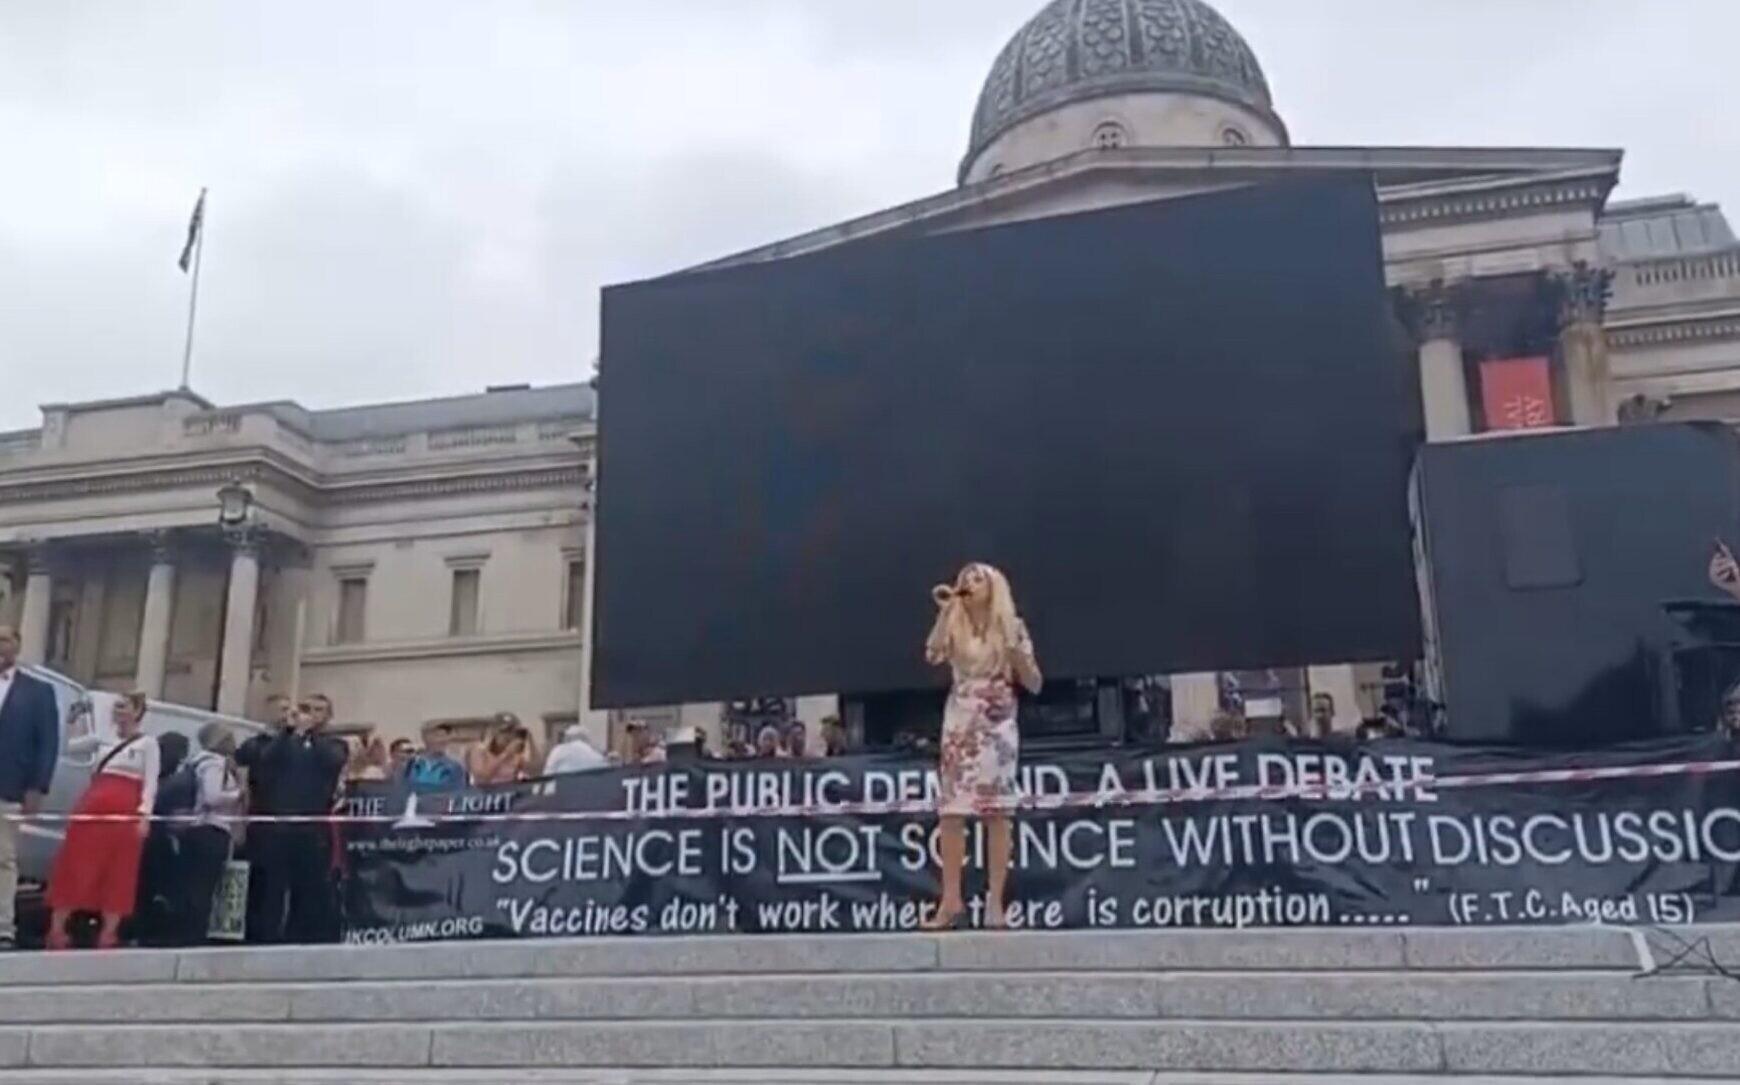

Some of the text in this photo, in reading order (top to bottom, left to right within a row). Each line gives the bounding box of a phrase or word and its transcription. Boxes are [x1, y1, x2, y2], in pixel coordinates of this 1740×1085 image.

[448, 792, 513, 812] LIGHT
[622, 774, 688, 818] THE
[706, 771, 850, 814] PUBLIC
[864, 765, 1069, 813] DEMND
[1098, 764, 1130, 806] A
[1145, 755, 1239, 800] LIVE
[1257, 753, 1438, 801] DEBATE
[492, 830, 703, 882] SCIENCE
[721, 828, 756, 874] IS
[778, 826, 881, 876] NOT
[901, 819, 1136, 870] SCINCE
[1162, 812, 1415, 867] WITHOUT
[661, 896, 738, 929] don't
[759, 892, 838, 927] work
[852, 892, 940, 929] wher
[969, 890, 1064, 928] tere
[1088, 888, 1117, 924] is
[1647, 892, 1694, 925] 15)
